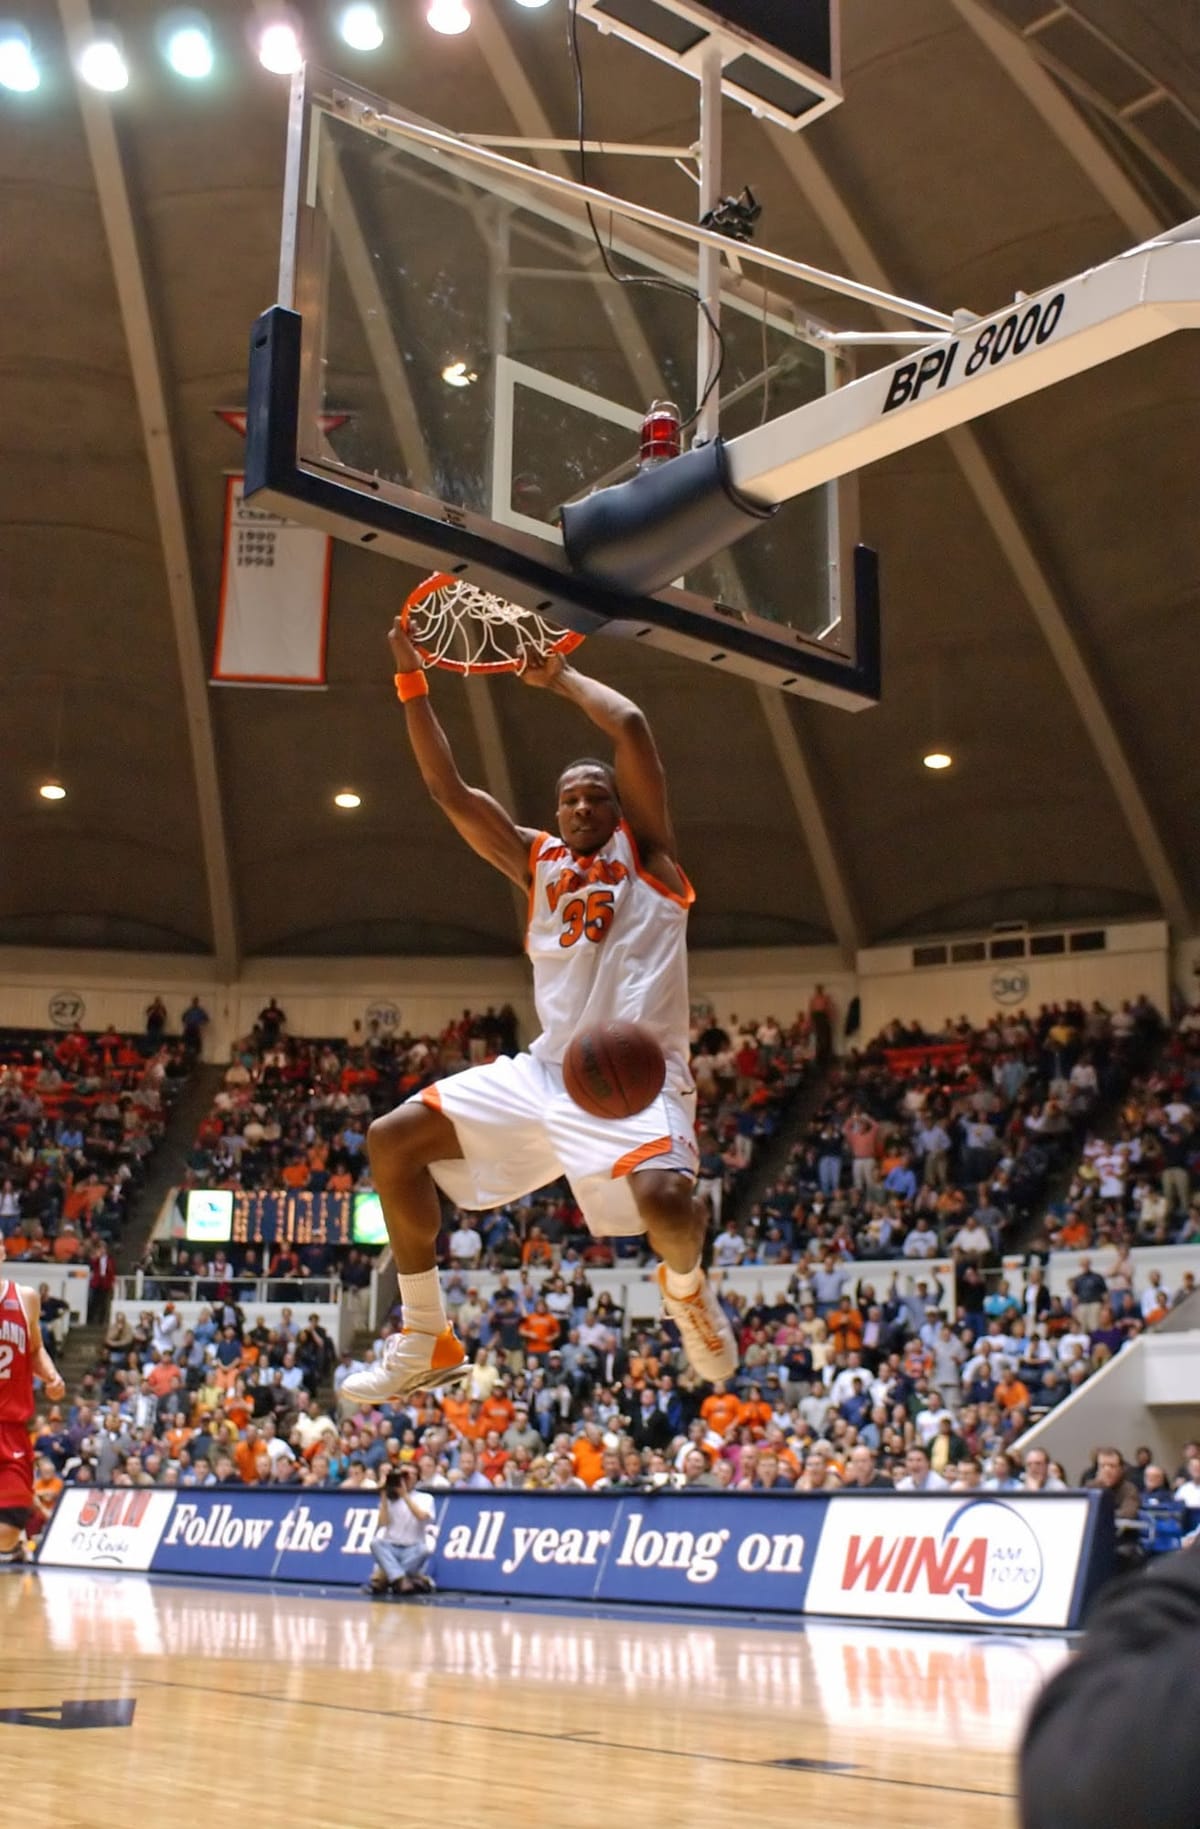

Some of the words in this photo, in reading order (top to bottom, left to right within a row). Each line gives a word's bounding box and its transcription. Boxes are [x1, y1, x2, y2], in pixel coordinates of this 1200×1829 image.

[882, 341, 960, 414] BPI
[965, 293, 1065, 376] 8000
[559, 891, 614, 947] 35
[53, 1001, 80, 1016] 27
[164, 1504, 272, 1550] Follow
[275, 1506, 333, 1552] the
[443, 1511, 505, 1559] all
[502, 1526, 610, 1573] year
[616, 1513, 730, 1583] long
[737, 1533, 805, 1572] on
[841, 1535, 988, 1596] WINA
[992, 1547, 1022, 1560] AM
[991, 1567, 1036, 1583] 1070
